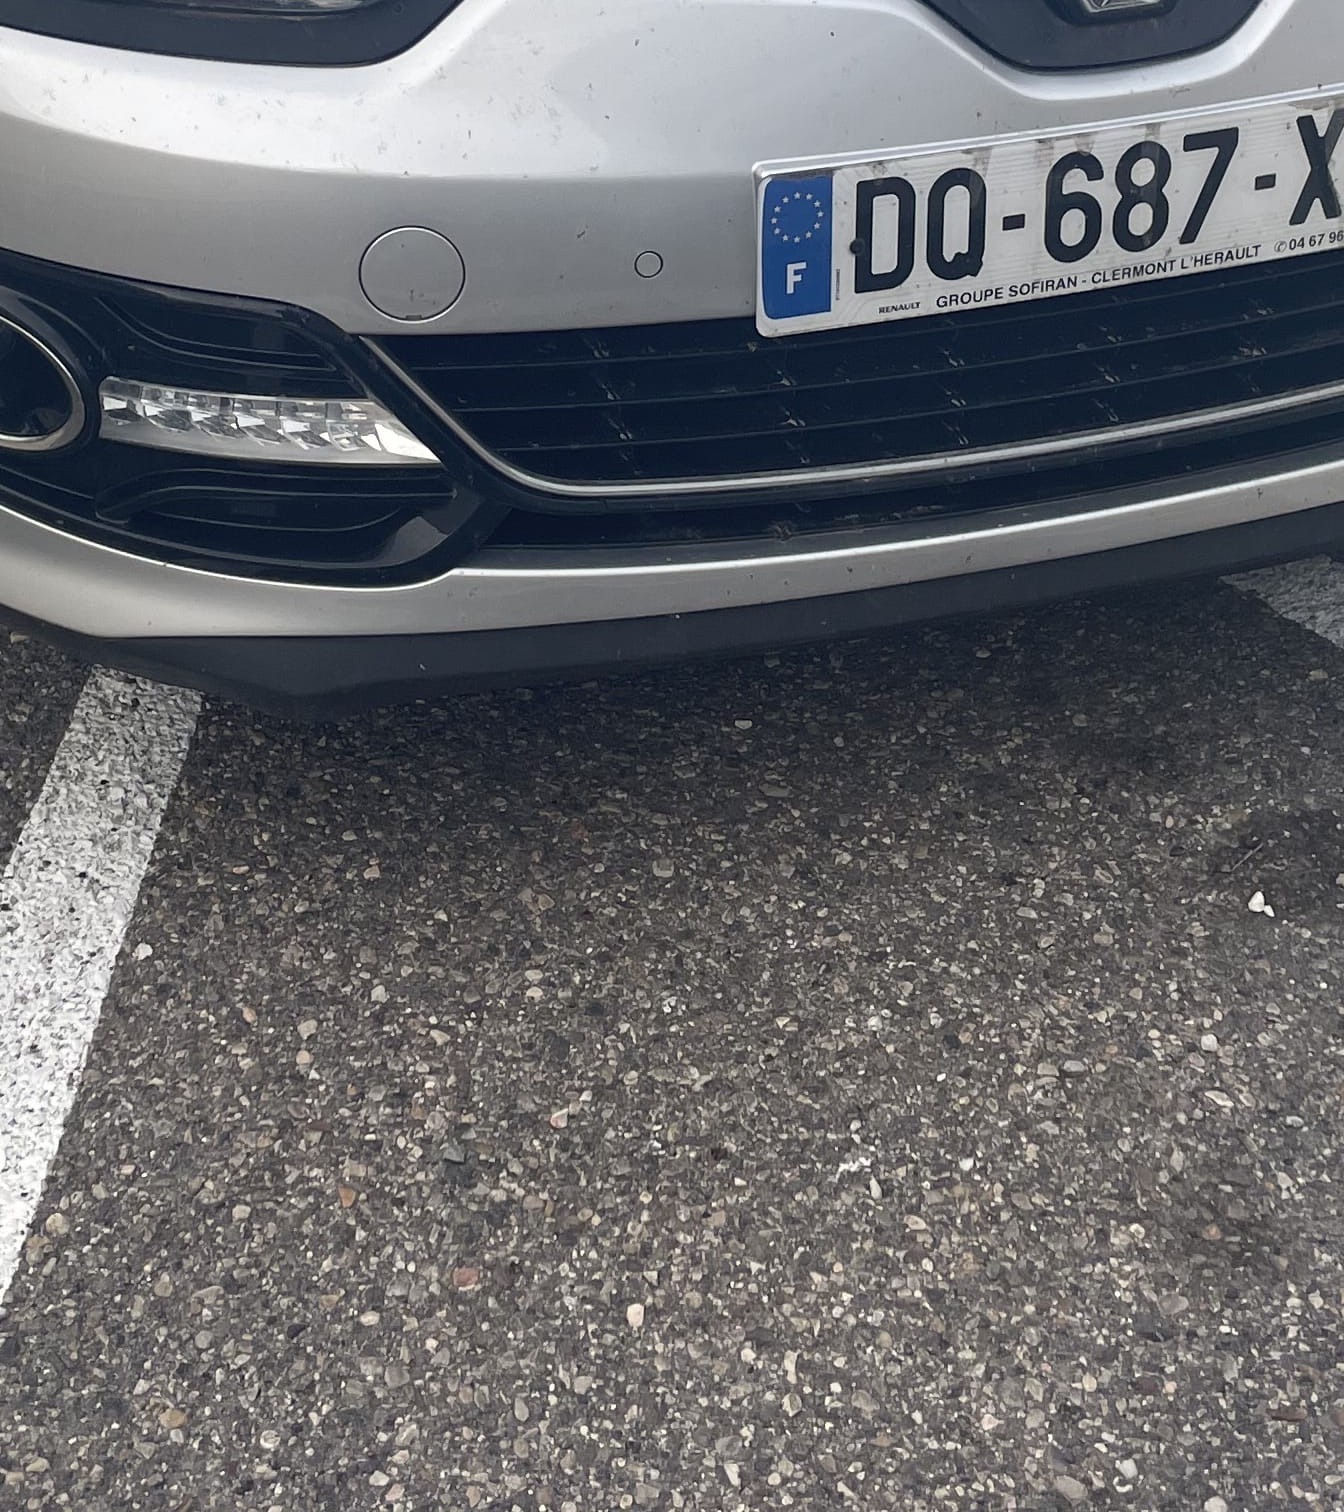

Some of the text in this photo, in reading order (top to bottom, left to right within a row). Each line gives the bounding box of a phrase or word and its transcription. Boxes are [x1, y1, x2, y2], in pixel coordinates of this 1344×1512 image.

[786, 262, 808, 295] F
[936, 286, 1004, 308] GROUPE
[1008, 276, 1078, 298] SOFIRAN
[1091, 259, 1177, 285] CLERMONT
[1180, 244, 1262, 270] L'HERAULT
[1288, 237, 1305, 251] 04
[1308, 233, 1325, 247] 67
[1328, 230, 1344, 244] 96
[878, 301, 921, 315] RENAULT
